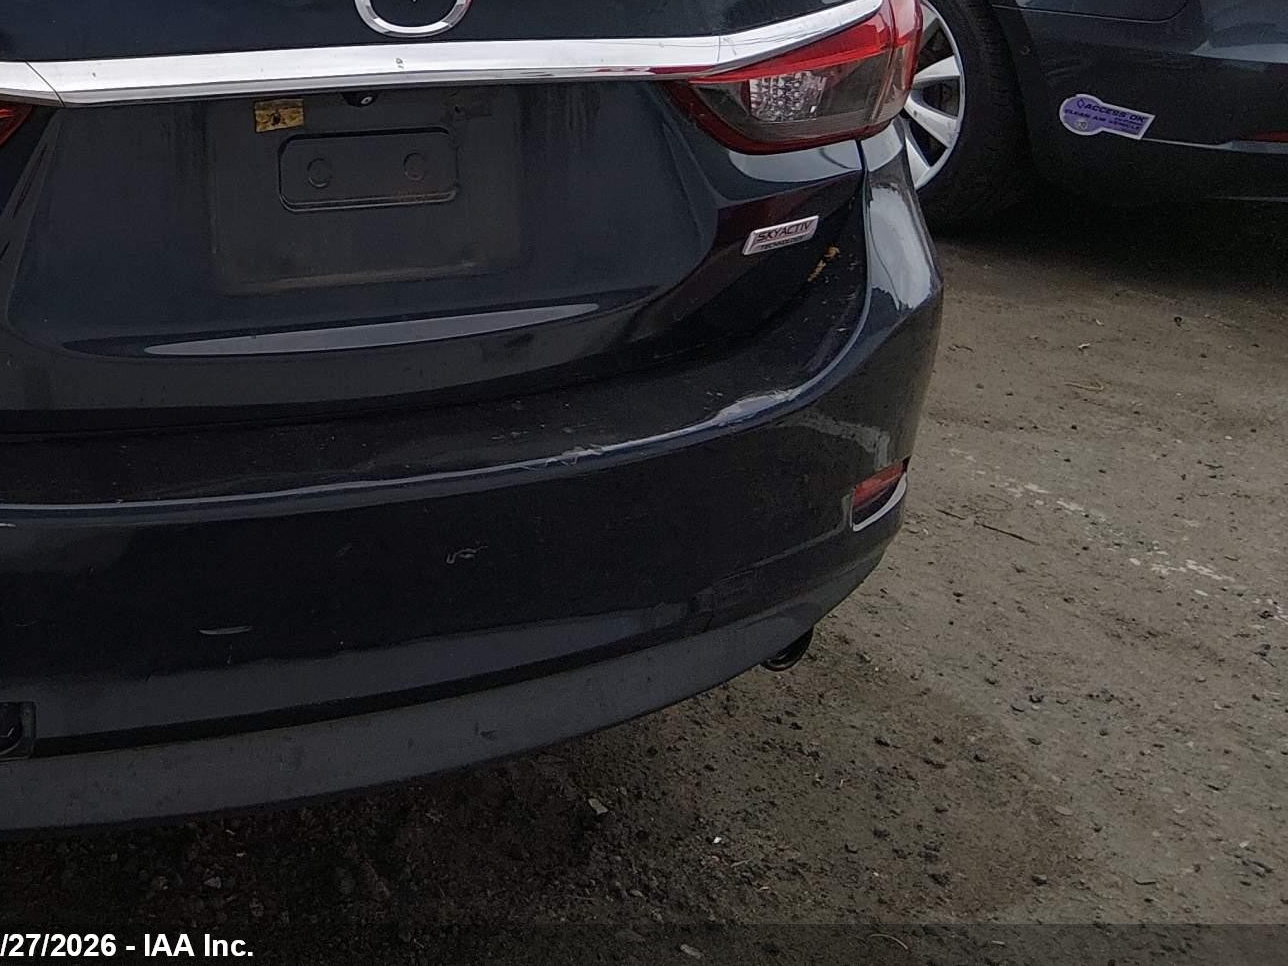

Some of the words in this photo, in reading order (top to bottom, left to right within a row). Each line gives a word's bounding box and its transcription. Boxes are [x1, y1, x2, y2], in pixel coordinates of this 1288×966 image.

[1083, 103, 1127, 118] ACCESS
[1129, 114, 1146, 124] OK
[757, 221, 813, 244] SKYACTIV
